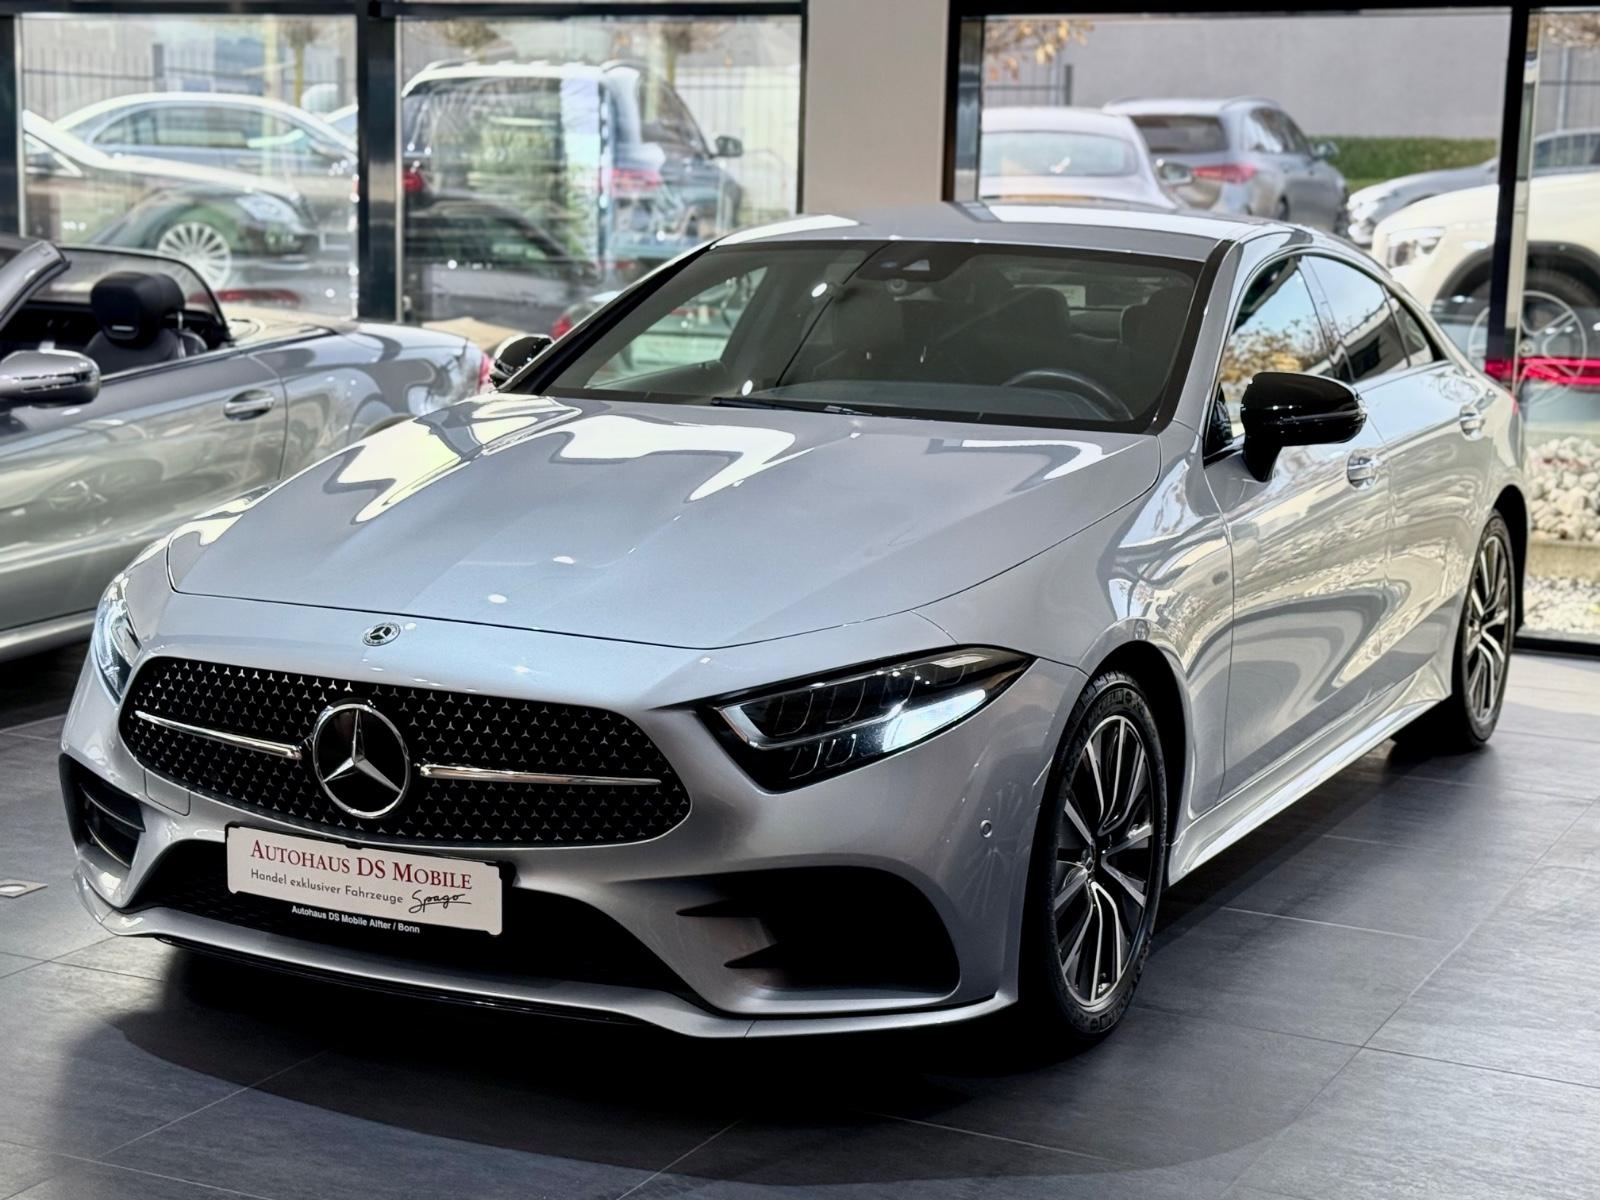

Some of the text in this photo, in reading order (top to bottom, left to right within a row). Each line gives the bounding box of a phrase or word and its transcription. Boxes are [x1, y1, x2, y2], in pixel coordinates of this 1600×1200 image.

[251, 839, 472, 890] AUTOHAUS DS MOBILE
[251, 868, 404, 905] Handel exklusiver Fahrzeuge
[291, 905, 327, 919] Autohaus
[328, 912, 340, 921] DS
[341, 914, 367, 926] Mobile
[398, 922, 420, 933] Bonn
